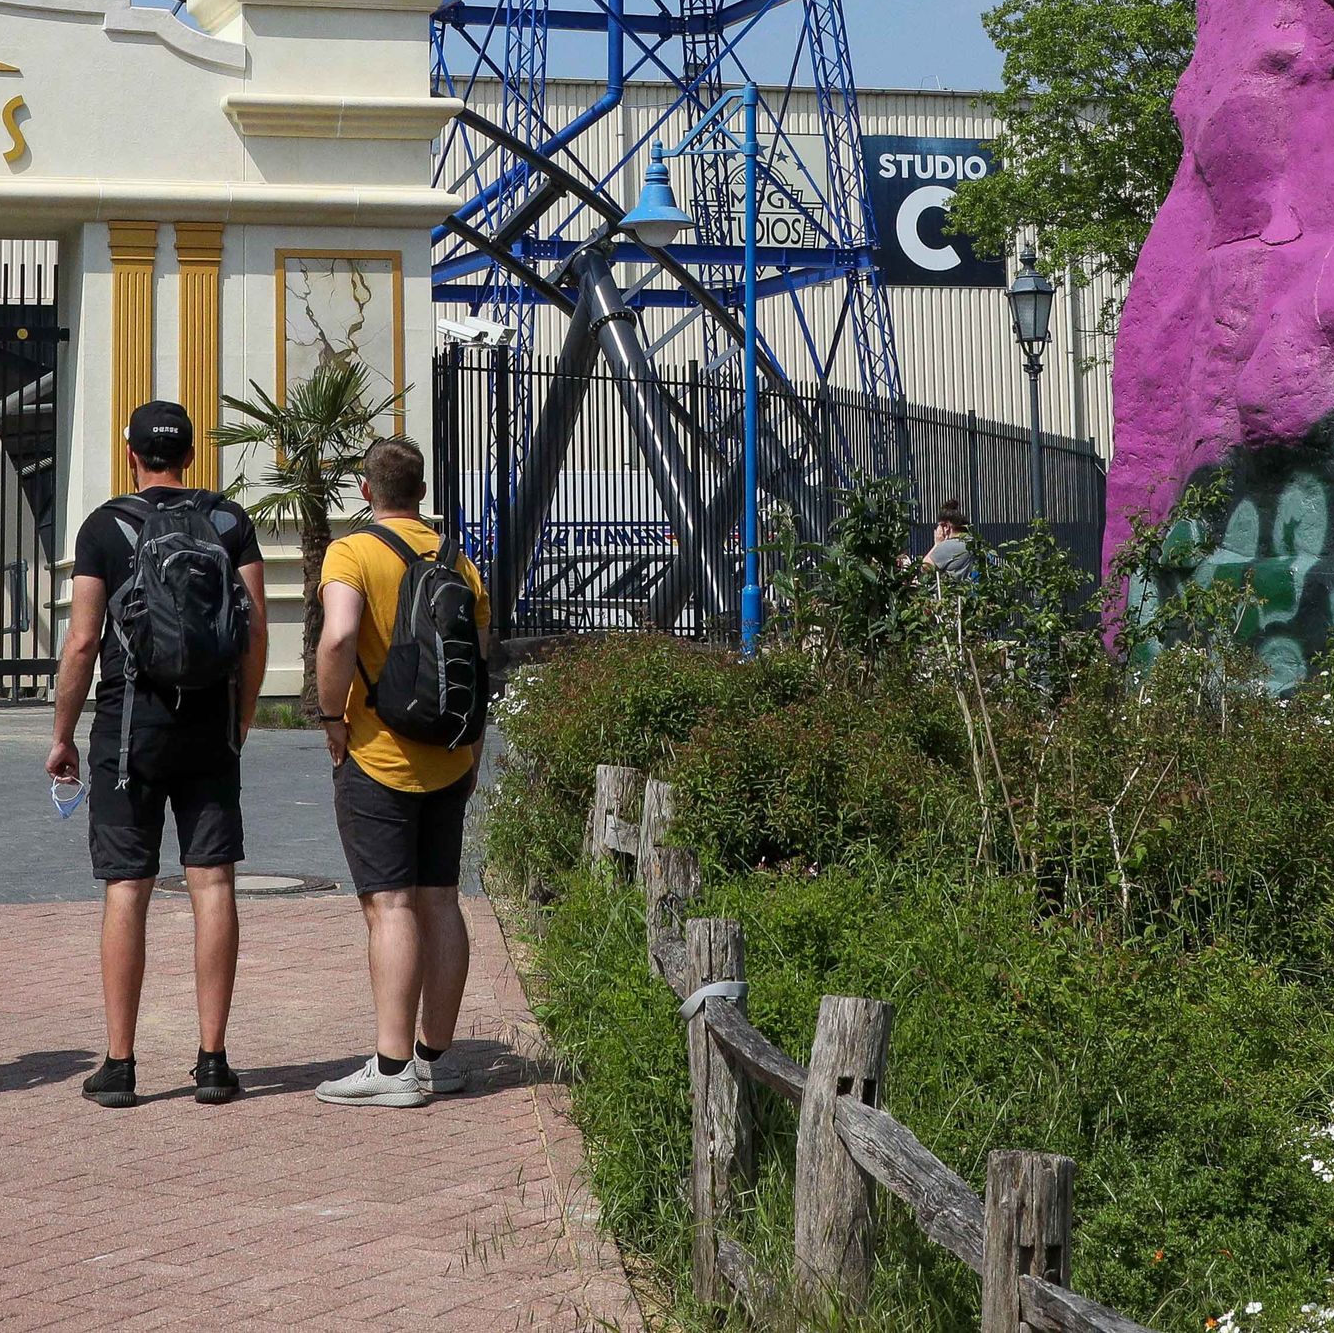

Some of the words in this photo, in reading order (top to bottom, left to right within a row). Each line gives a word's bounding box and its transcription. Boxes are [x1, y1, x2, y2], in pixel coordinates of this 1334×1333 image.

[878, 153, 987, 180] STUDIO
[731, 189, 784, 209] MG
[714, 217, 802, 245] TUDIOS
[896, 185, 962, 271] C
